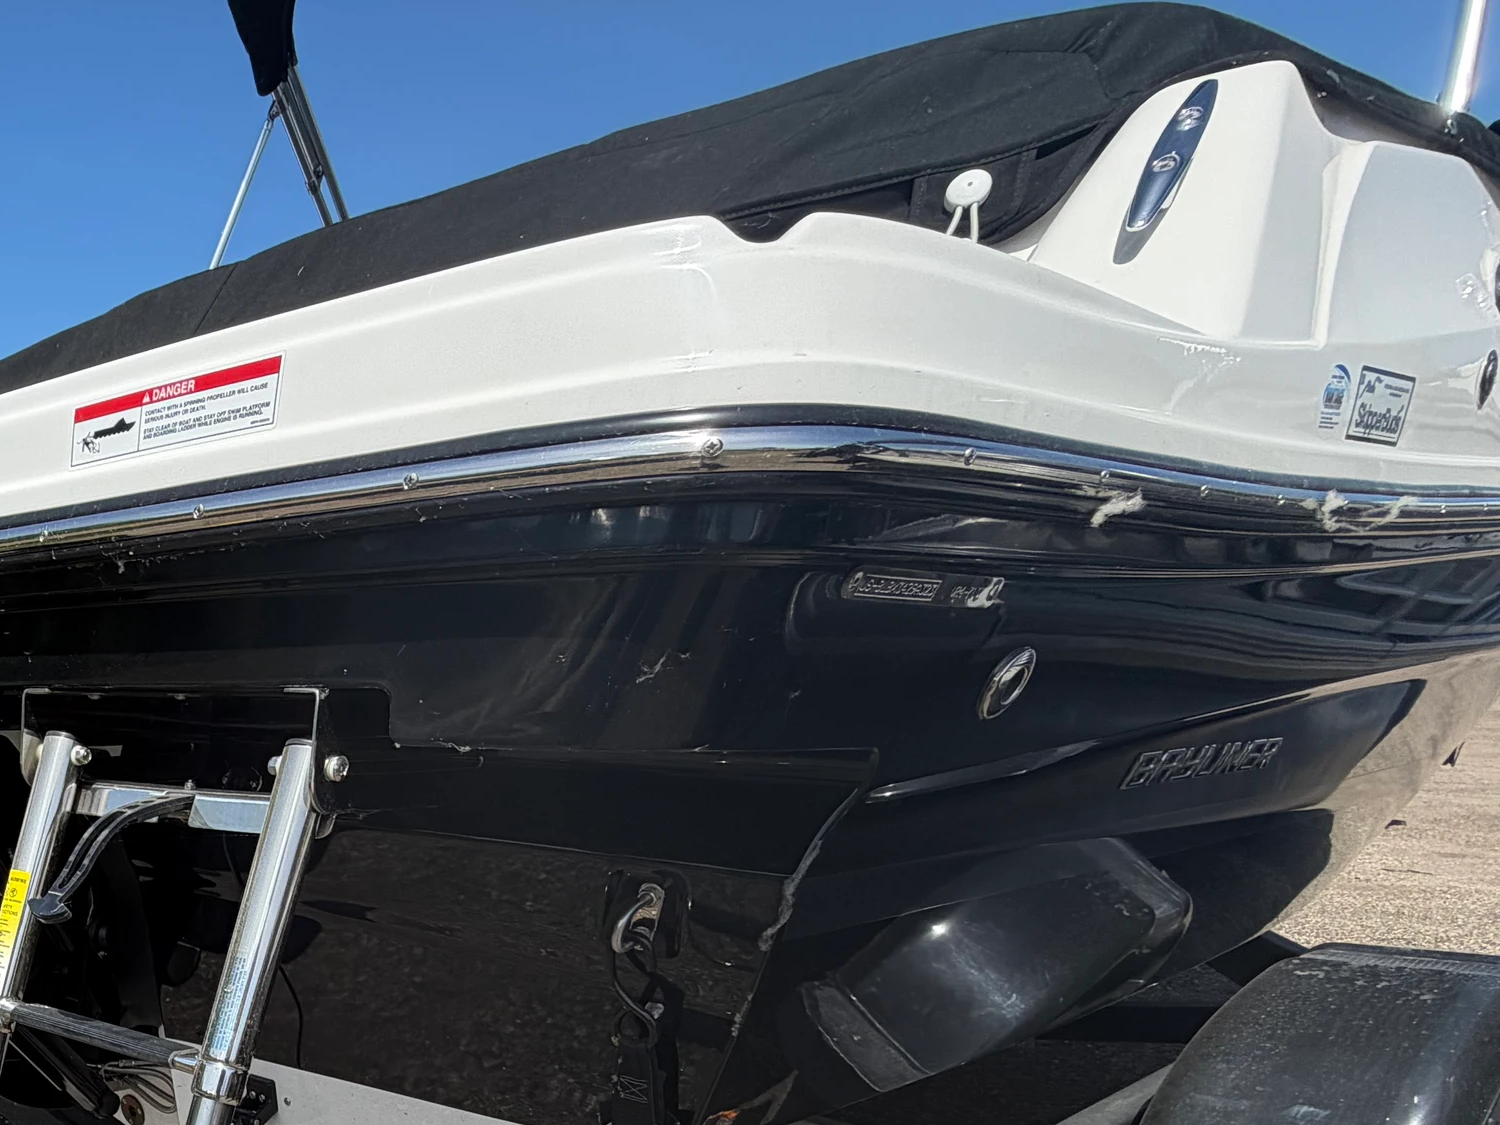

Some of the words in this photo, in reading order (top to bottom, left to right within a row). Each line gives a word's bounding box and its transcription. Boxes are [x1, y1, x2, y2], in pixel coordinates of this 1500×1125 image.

[144, 406, 166, 417] CONTACT
[167, 403, 179, 411] WITH
[184, 396, 206, 408] SPINNING
[206, 389, 236, 401] PROPELLER
[237, 386, 249, 395] WILL
[250, 382, 269, 392] CAUSE
[152, 379, 196, 401] DANGER
[143, 427, 154, 435] STAY
[155, 423, 170, 432] CLEAR
[178, 418, 192, 427] BOAT
[192, 415, 203, 423] AND
[203, 412, 216, 421] STAY
[216, 410, 227, 418] OFF
[227, 407, 241, 415] SWIM
[242, 400, 271, 412] PLATFORM
[144, 414, 164, 425] SERIOUS
[164, 410, 181, 420] INJURY
[182, 408, 189, 416] OR
[153, 427, 177, 438] BOARDING
[178, 423, 197, 433] LADDER
[197, 418, 213, 428] WHILE
[213, 415, 232, 425] ENGINE
[1119, 737, 1283, 790] BAYLINER
